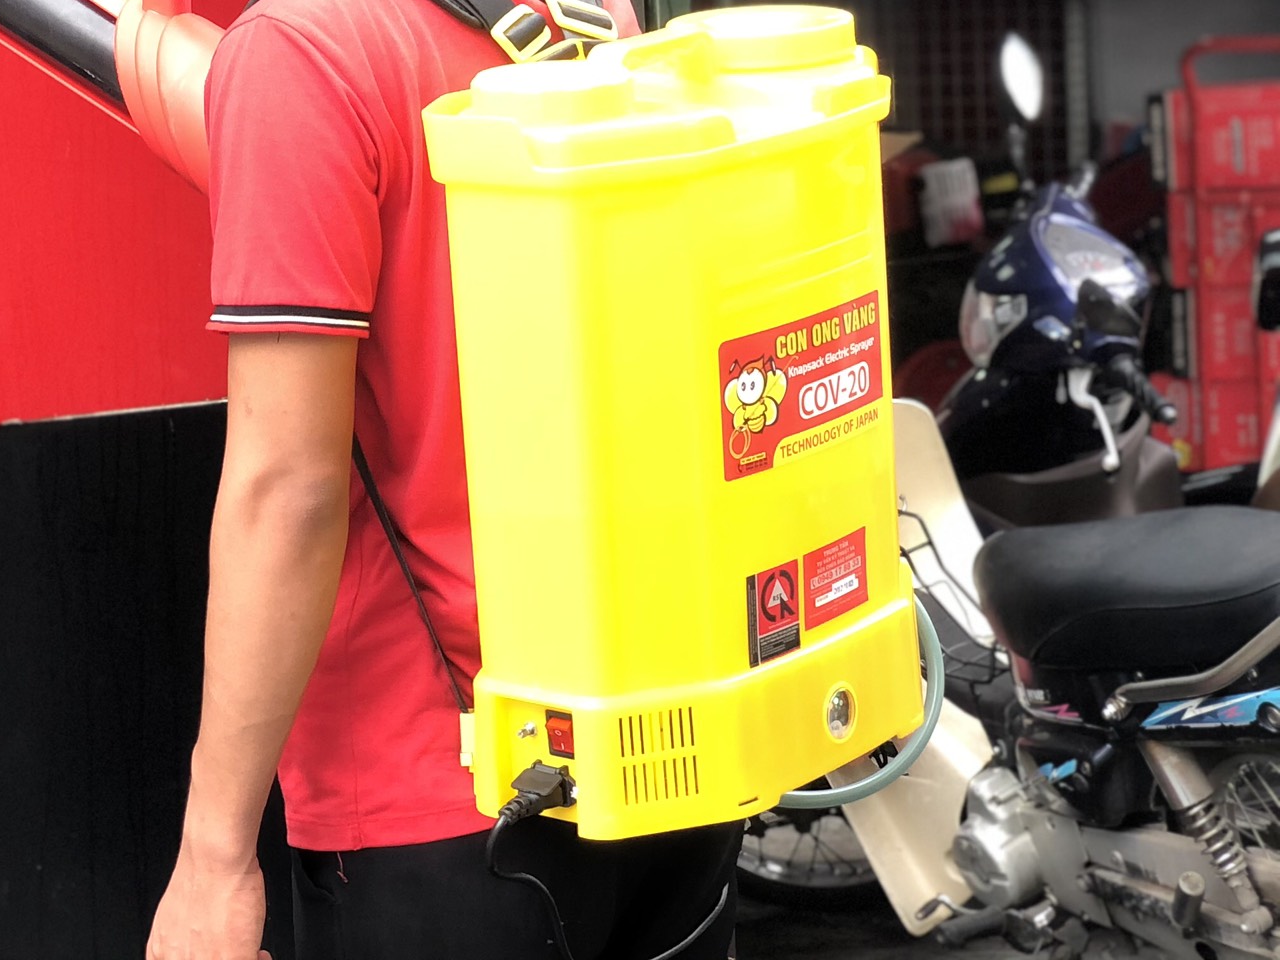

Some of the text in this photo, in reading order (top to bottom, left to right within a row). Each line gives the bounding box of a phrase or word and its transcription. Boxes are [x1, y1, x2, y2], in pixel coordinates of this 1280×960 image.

[776, 302, 875, 359] CON ONG VÀNG
[788, 336, 875, 378] Knapsack Electric Sprayer
[801, 365, 867, 416] COV-20
[780, 407, 880, 458] TECHNOLOGY OF JAPAN
